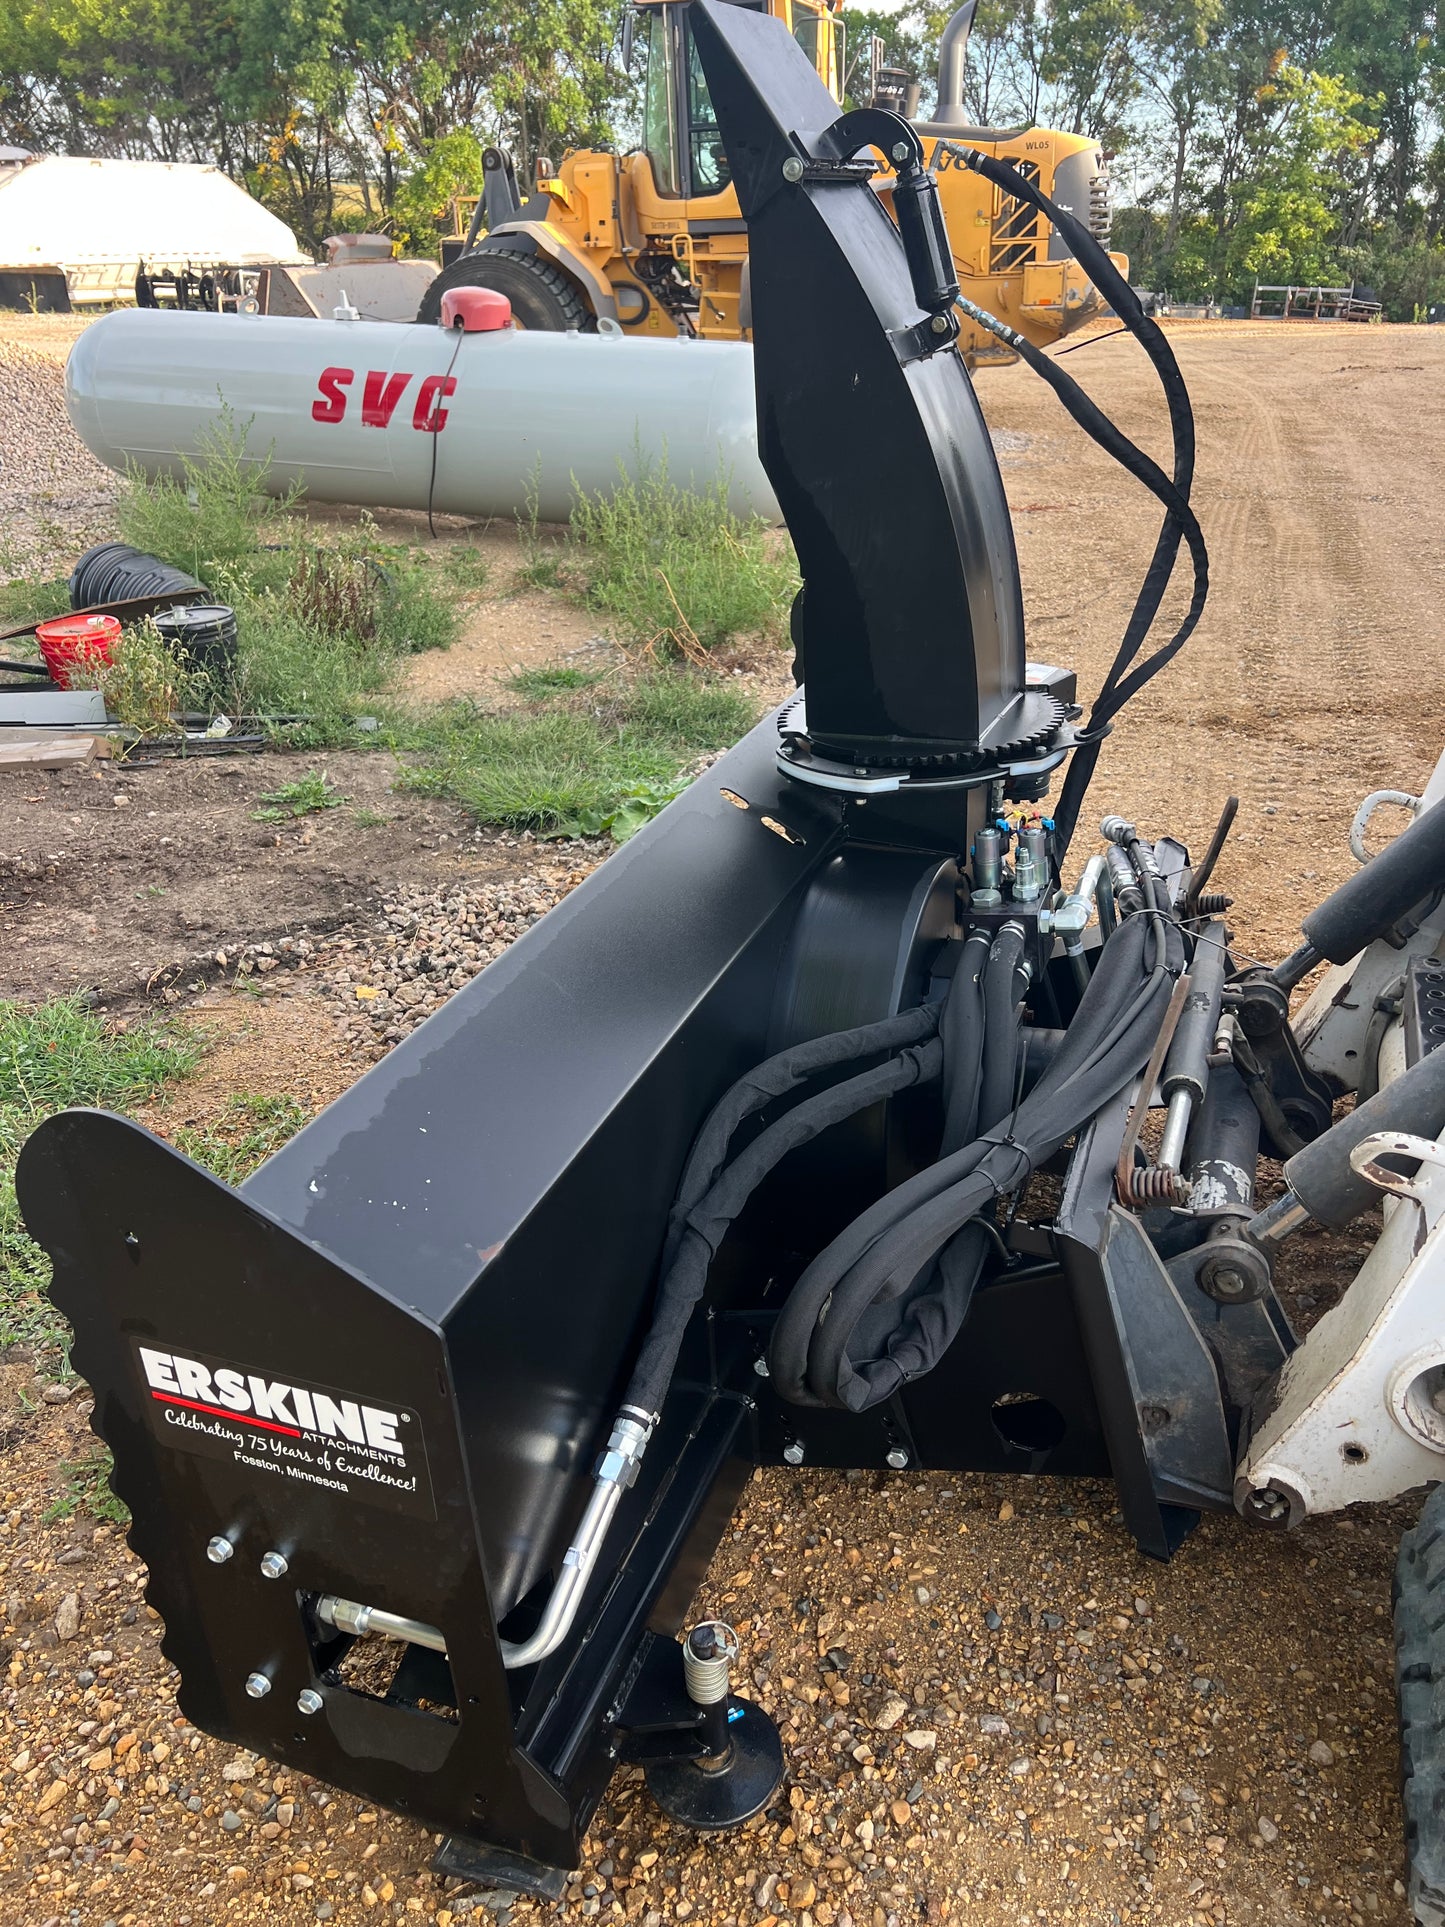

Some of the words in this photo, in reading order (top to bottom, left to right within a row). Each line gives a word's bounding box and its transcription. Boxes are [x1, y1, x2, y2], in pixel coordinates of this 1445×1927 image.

[138, 1347, 404, 1455] ERSKINE
[164, 1408, 244, 1448] Celebrating
[247, 1434, 268, 1451] 75
[269, 1438, 314, 1463] Years
[316, 1450, 332, 1472] of
[334, 1456, 417, 1492] Excellence!
[233, 1450, 285, 1475] Fosston,
[286, 1465, 349, 1493] Minnesota
[302, 1431, 408, 1469] ATTACHMENTS
